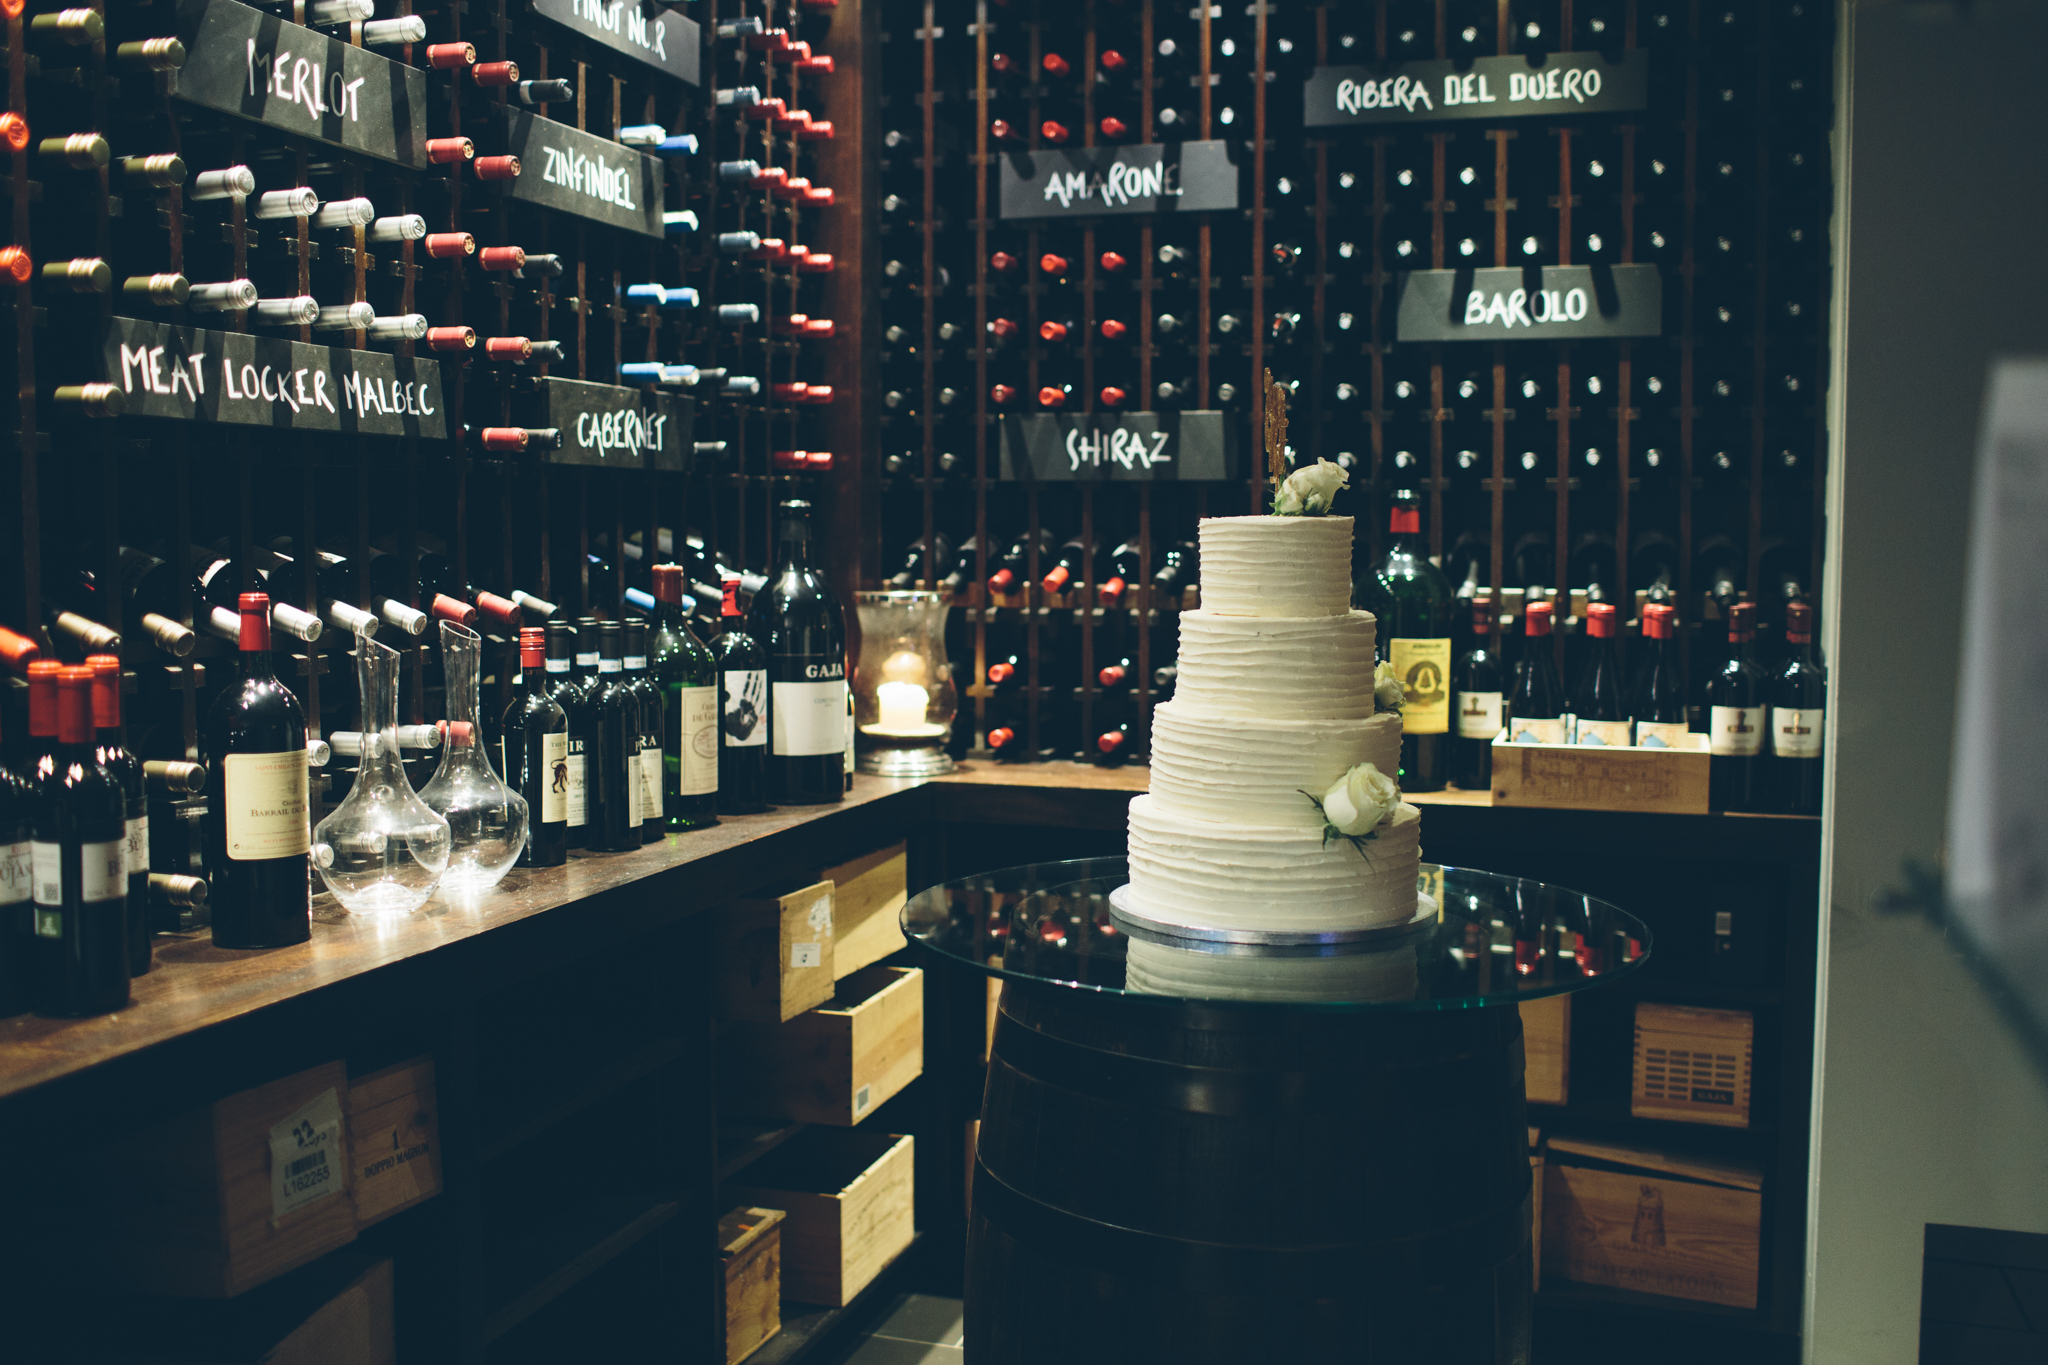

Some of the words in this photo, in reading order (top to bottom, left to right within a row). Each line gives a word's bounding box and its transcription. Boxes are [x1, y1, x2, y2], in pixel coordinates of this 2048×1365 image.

[628, 5, 667, 61] NOR
[247, 38, 365, 122] MERLOT
[1336, 75, 1433, 115] RIBERA
[1444, 73, 1496, 105] DEL
[1509, 68, 1601, 103] DUERO
[542, 146, 636, 210] ZINFINDEL
[1043, 160, 1184, 208] AMARONE
[1464, 288, 1588, 329] BAROLO
[121, 343, 207, 402] MEAT
[224, 358, 335, 413] LOCKER
[343, 370, 434, 418] MALBEC
[577, 406, 668, 457] CABERNET
[1065, 427, 1172, 471] SHIRAZ
[806, 663, 844, 679] GAJA
[251, 807, 291, 818] BARRAIL
[364, 1156, 396, 1180] DOPPIO
[396, 1141, 430, 1166] MAGNUM
[391, 1129, 400, 1152] 1
[283, 1165, 331, 1199] L162255
